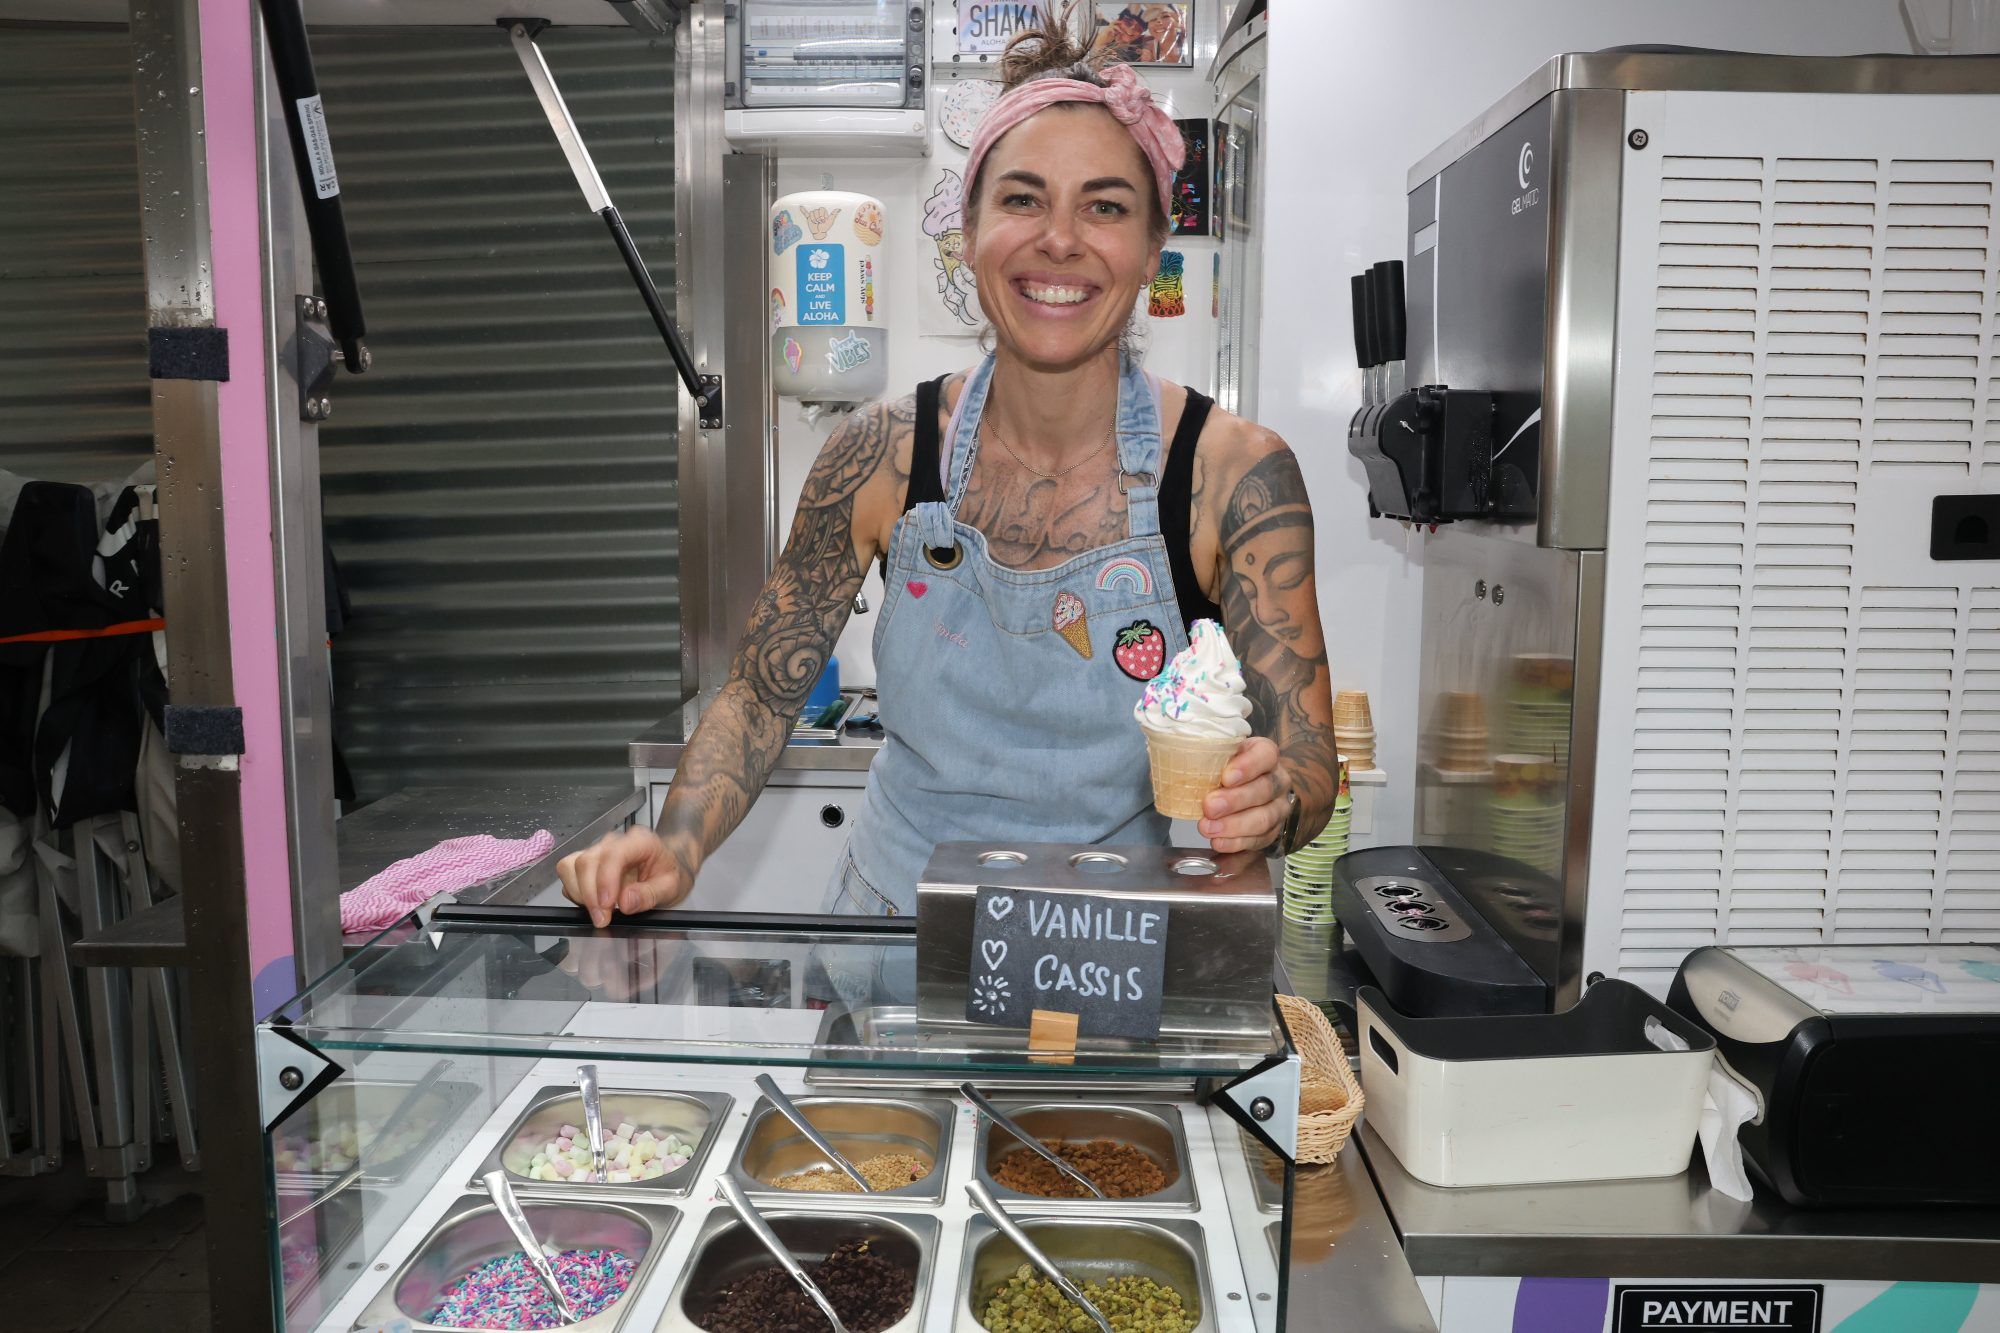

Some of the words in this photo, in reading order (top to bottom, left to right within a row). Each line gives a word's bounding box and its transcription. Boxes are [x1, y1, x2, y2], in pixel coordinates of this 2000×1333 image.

[969, 4, 1042, 37] SHAKA
[807, 273, 833, 281] KEEP
[805, 284, 835, 292] CALM
[809, 301, 832, 310] LIVE
[802, 312, 839, 321] ALOHA
[1029, 899, 1160, 944] VANILLE
[1034, 954, 1143, 1001] CASSIS
[1642, 1301, 1793, 1324] PAYMENT
